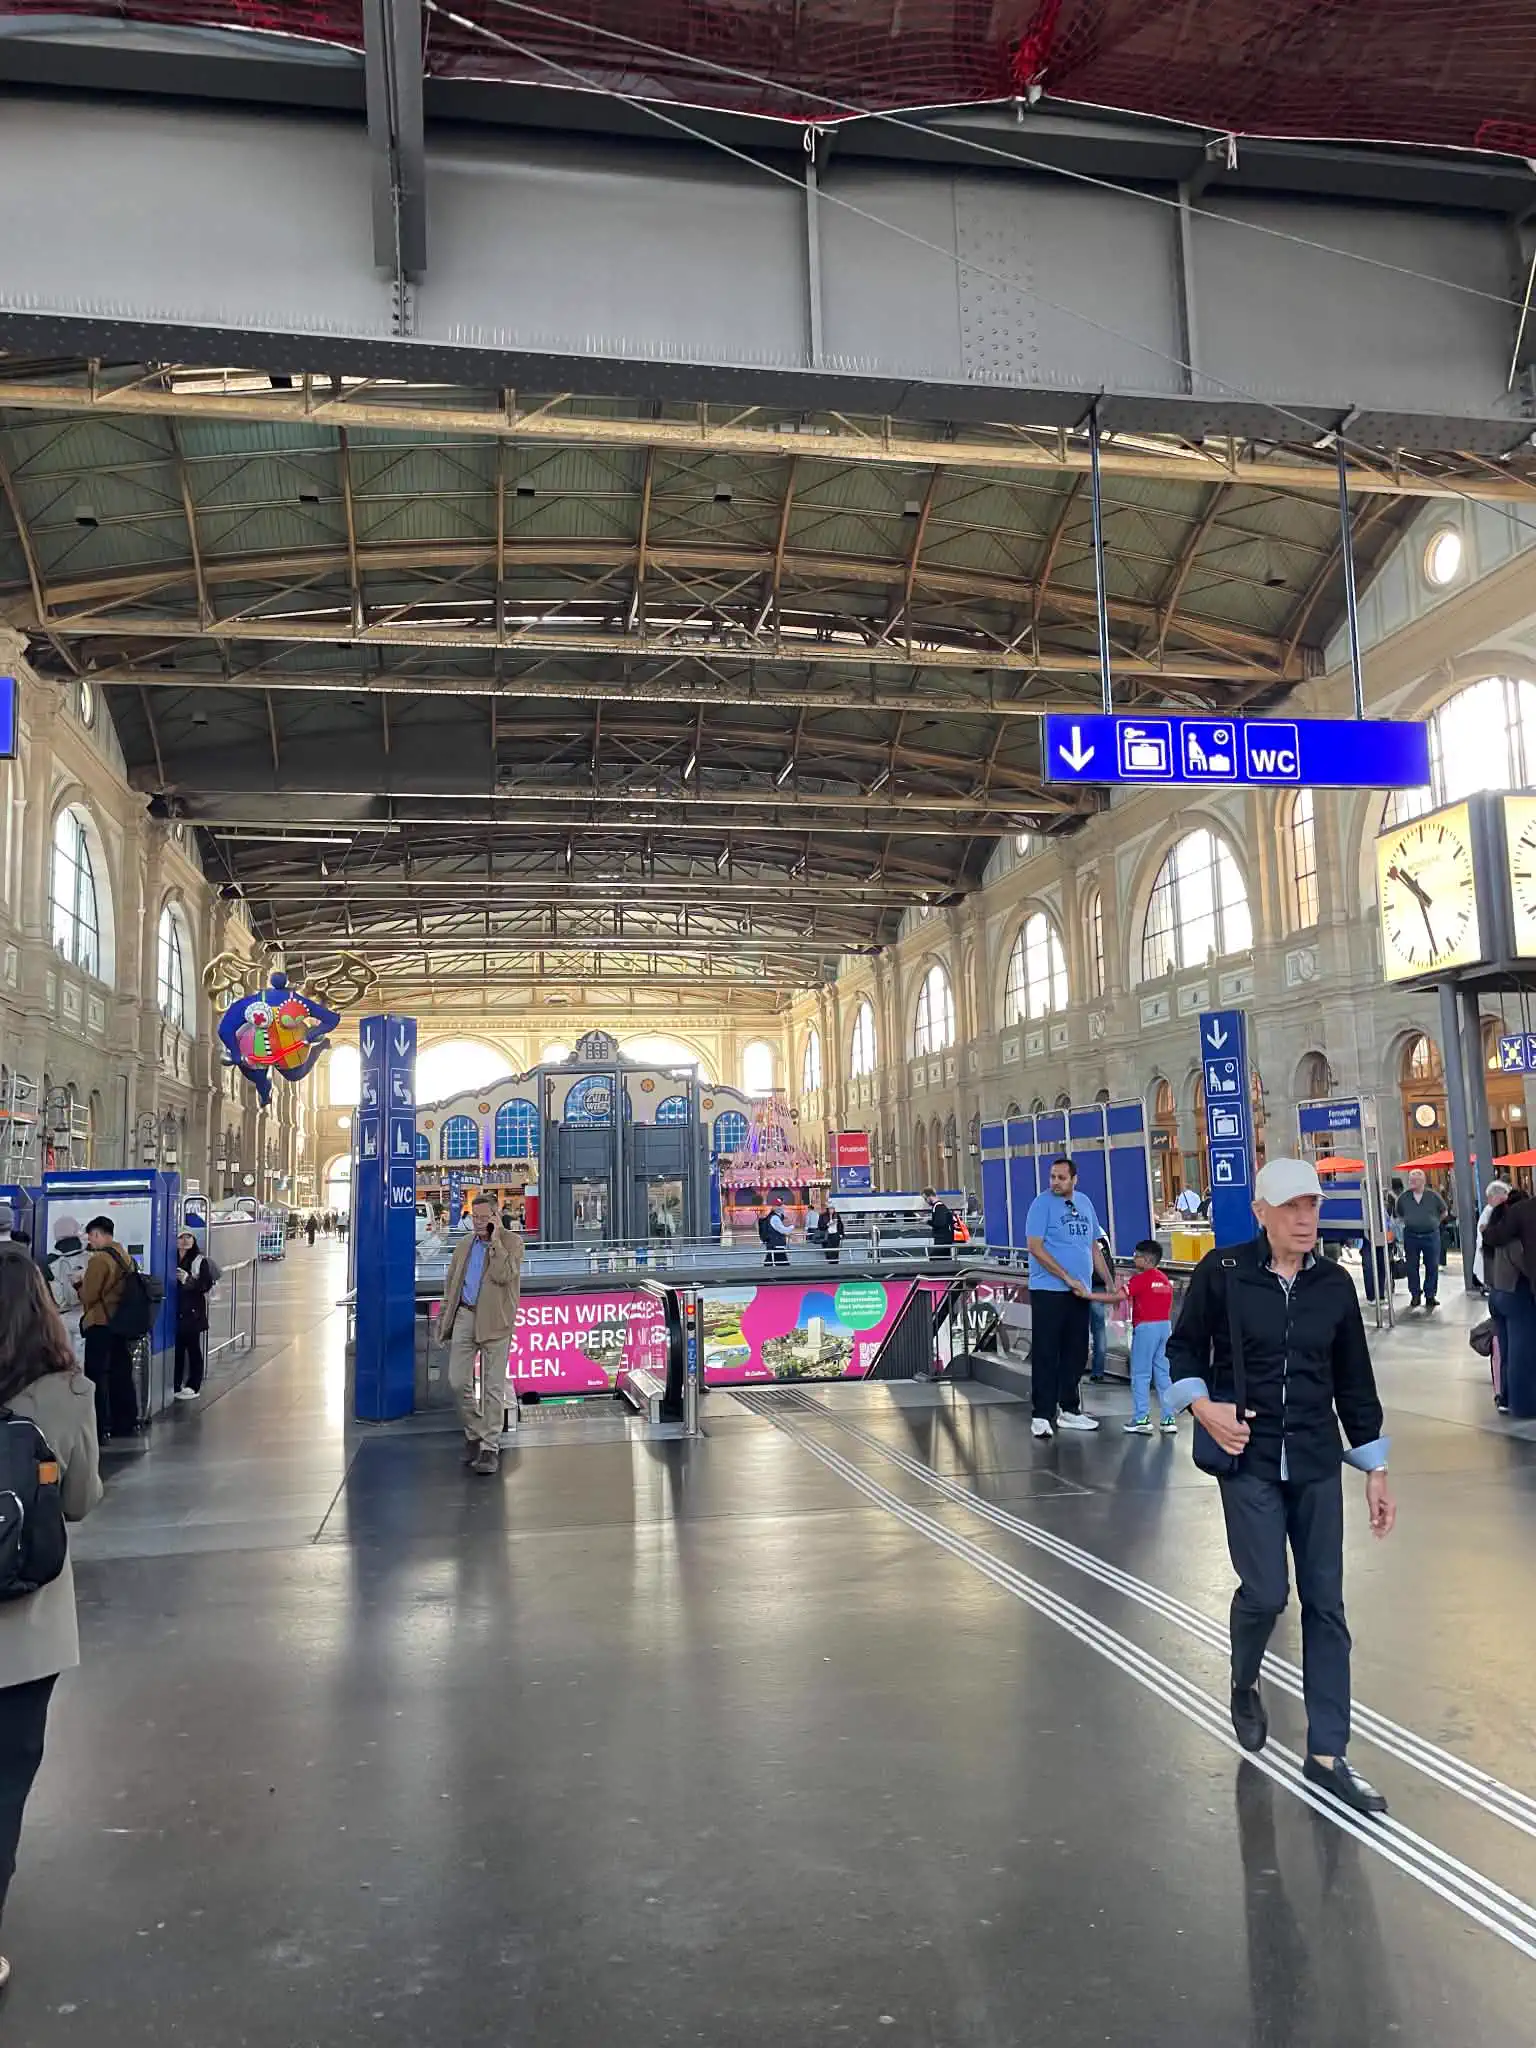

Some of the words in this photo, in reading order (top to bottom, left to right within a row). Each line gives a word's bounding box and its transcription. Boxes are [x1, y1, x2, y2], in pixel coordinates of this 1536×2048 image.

[1251, 749, 1295, 773] WC
[392, 1187, 412, 1204] WC
[1069, 1223, 1088, 1236] GAP
